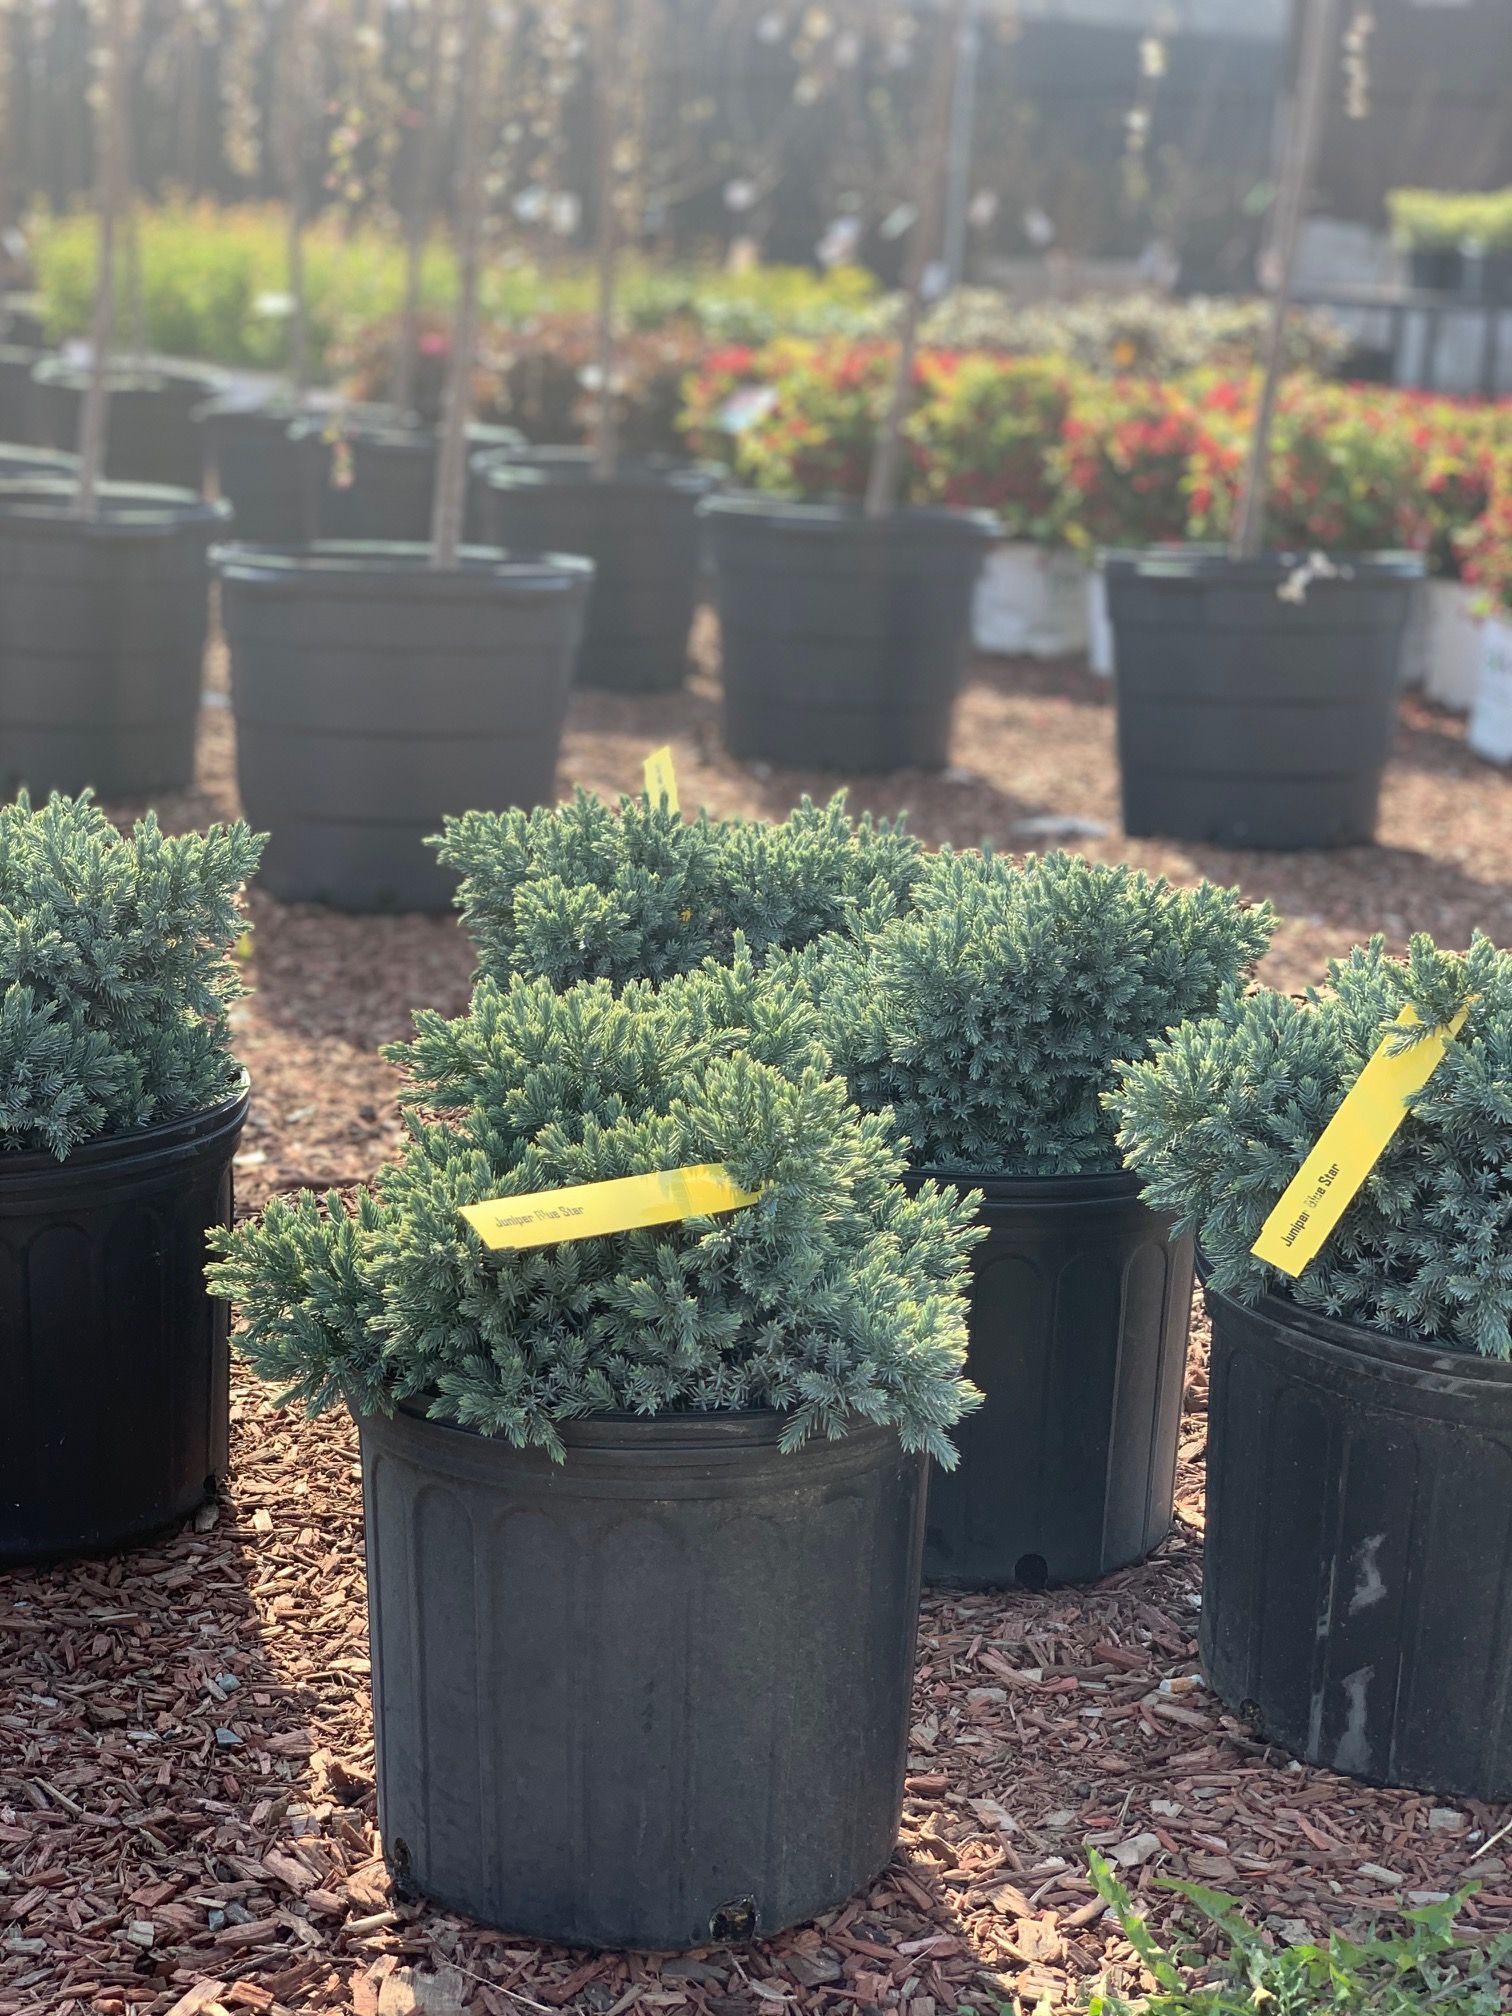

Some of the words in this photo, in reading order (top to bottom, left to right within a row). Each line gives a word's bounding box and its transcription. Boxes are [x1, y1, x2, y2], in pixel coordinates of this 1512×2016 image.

[494, 1215, 533, 1228] Juniper
[558, 1206, 584, 1217] Star
[1281, 1210, 1310, 1247] Juniper
[1318, 1163, 1340, 1187] Star
